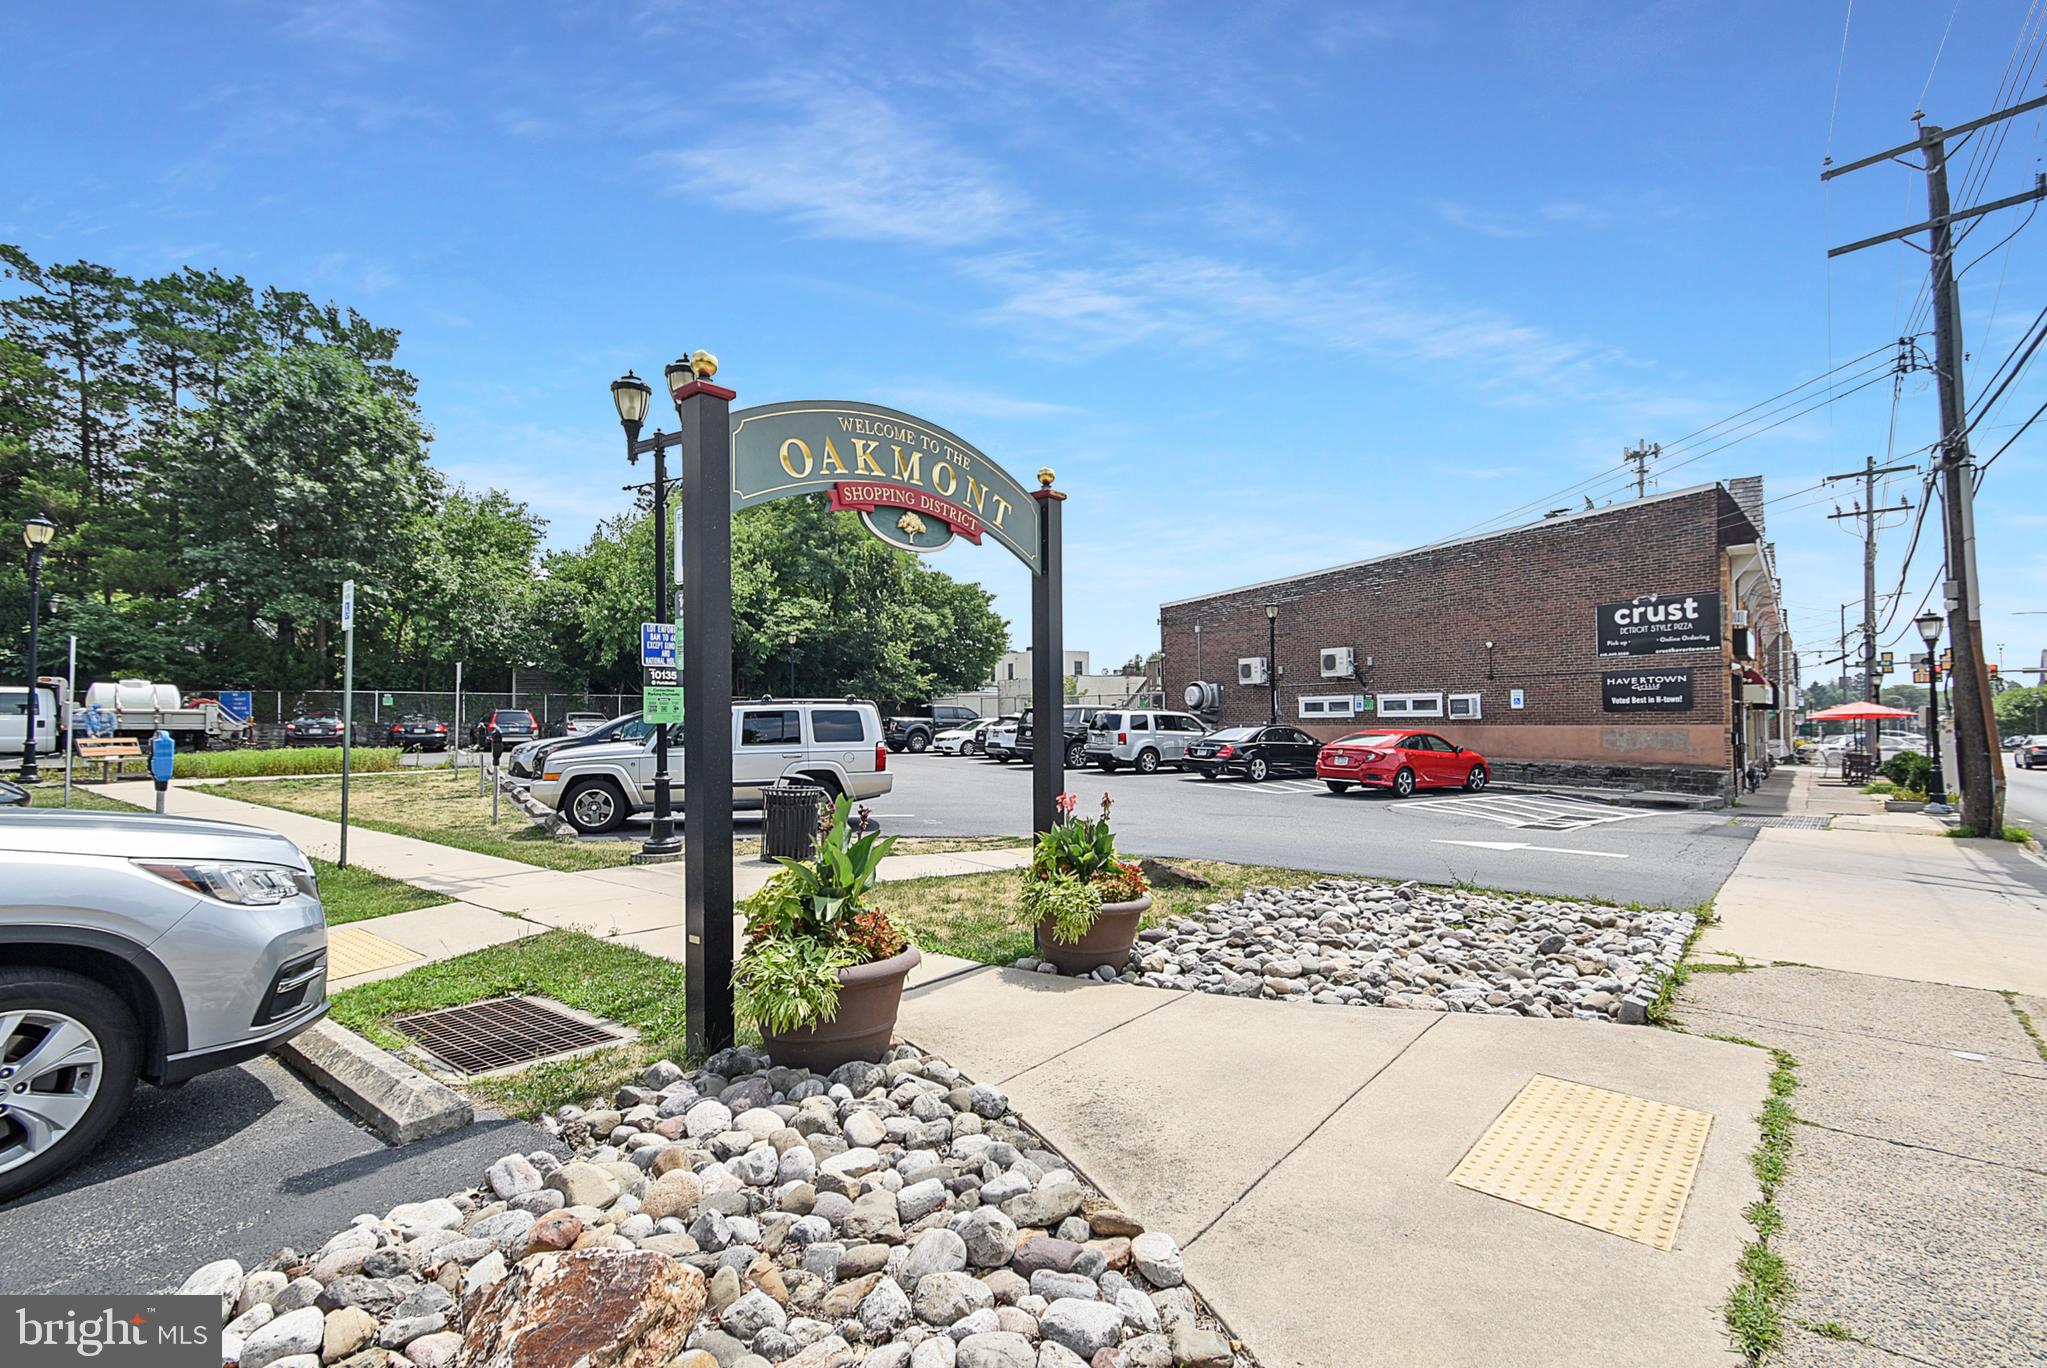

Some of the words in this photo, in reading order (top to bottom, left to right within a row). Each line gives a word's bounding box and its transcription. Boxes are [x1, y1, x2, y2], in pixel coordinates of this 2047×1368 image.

[837, 416, 916, 446] WELCOME
[920, 435, 940, 454] TO
[944, 446, 971, 471] THE
[778, 435, 1014, 531] OAKMONT
[843, 486, 916, 505] SHOPPING
[920, 495, 978, 531] DISTRICT
[1613, 597, 1700, 625] crust
[1619, 625, 1649, 635] DETROIT
[1650, 623, 1672, 633] STYLE
[1673, 622, 1694, 630] PIZZA
[1681, 634, 1711, 642] Ordering
[647, 641, 663, 649] EXCEPT
[651, 670, 677, 680] 10135
[1606, 675, 1688, 685] HAVERTOWN
[1611, 696, 1631, 705] Voted
[1631, 695, 1647, 704] Best
